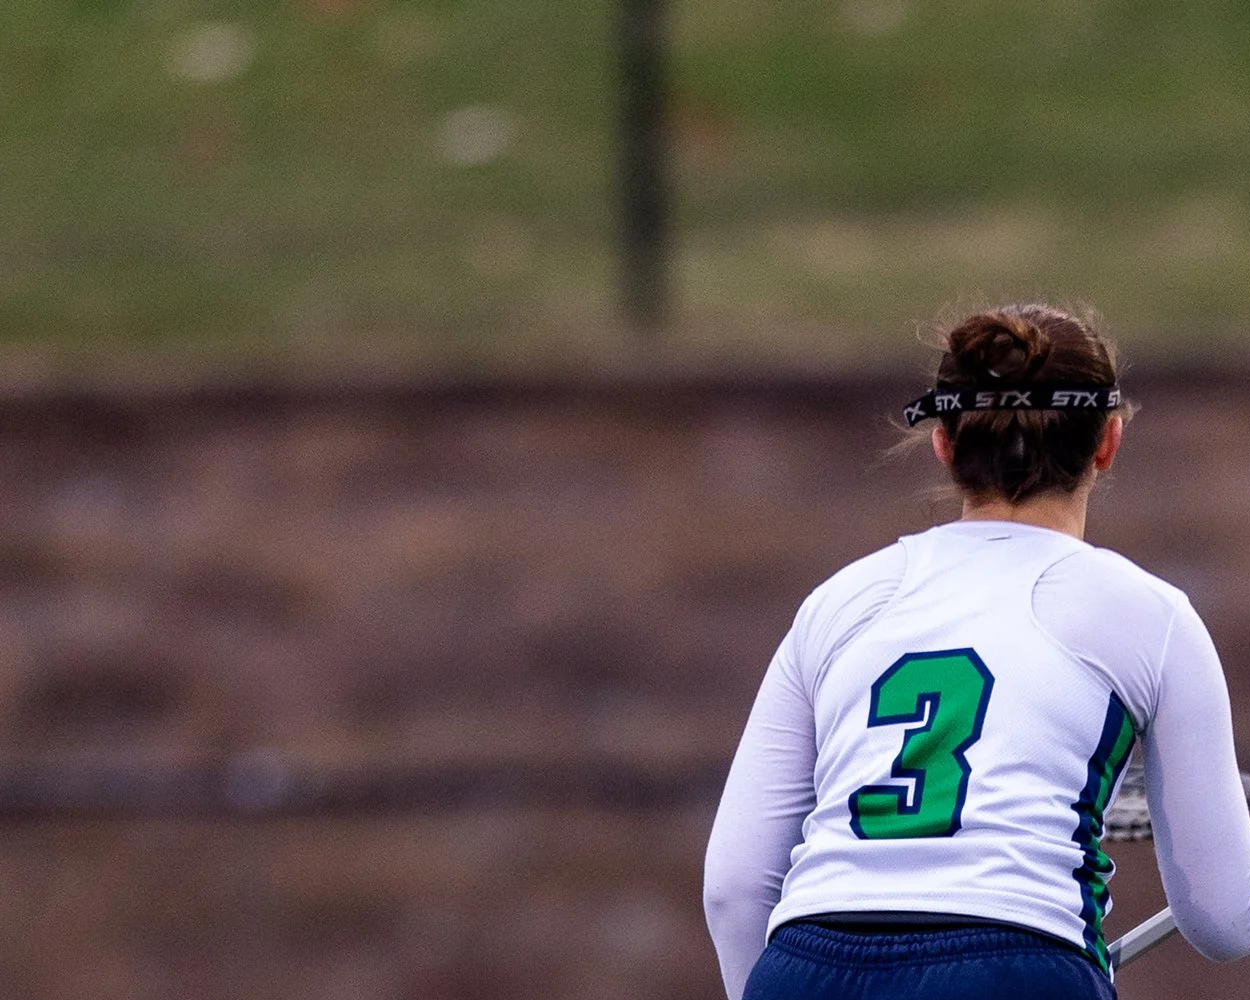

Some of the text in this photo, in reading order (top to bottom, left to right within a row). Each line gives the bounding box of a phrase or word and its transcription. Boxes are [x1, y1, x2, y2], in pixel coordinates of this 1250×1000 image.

[935, 392, 962, 412] STX
[975, 390, 1032, 408] STX
[1051, 390, 1098, 407] STX
[848, 647, 995, 840] 3
